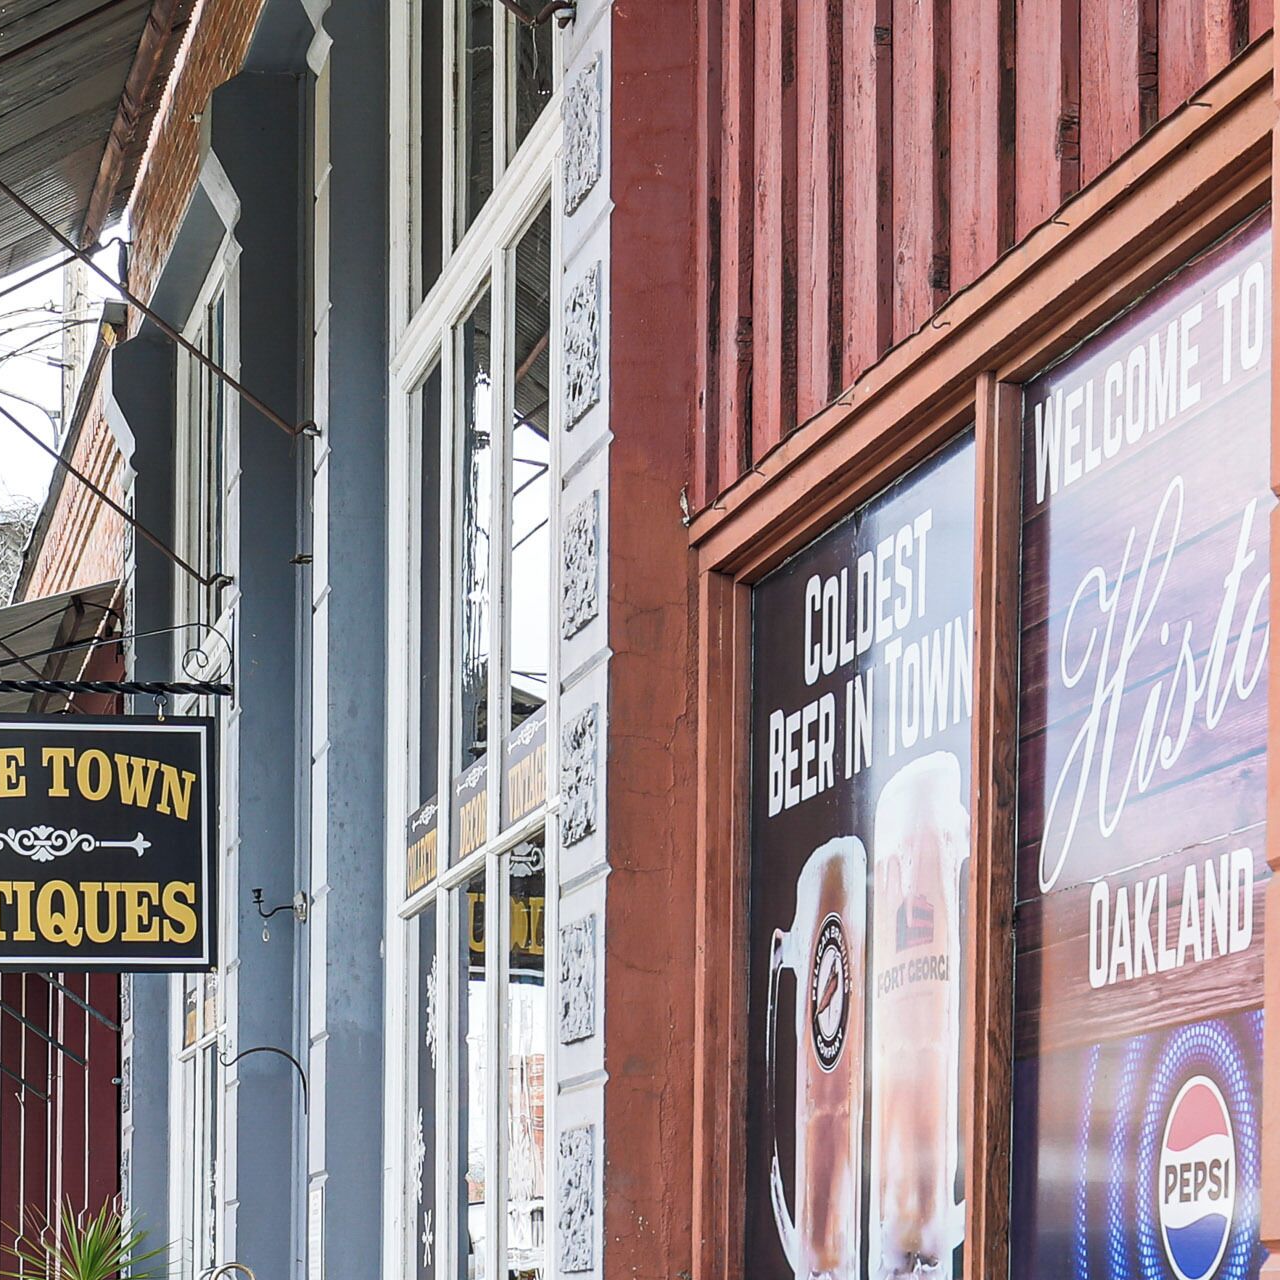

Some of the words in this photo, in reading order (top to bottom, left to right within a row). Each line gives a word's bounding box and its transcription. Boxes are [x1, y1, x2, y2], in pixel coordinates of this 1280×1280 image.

[1034, 303, 1202, 504] WELCOME
[1216, 261, 1265, 385] TO
[804, 509, 933, 686] COLDEST
[768, 692, 835, 818] BEER
[844, 668, 874, 781] IN
[884, 608, 974, 758] TOWN
[41, 747, 197, 821] TOWN
[1089, 847, 1254, 988] OAKLAND
[877, 962, 906, 998] FORT
[816, 1027, 843, 1059] COMPANY
[1164, 1158, 1230, 1204] PEPSI
